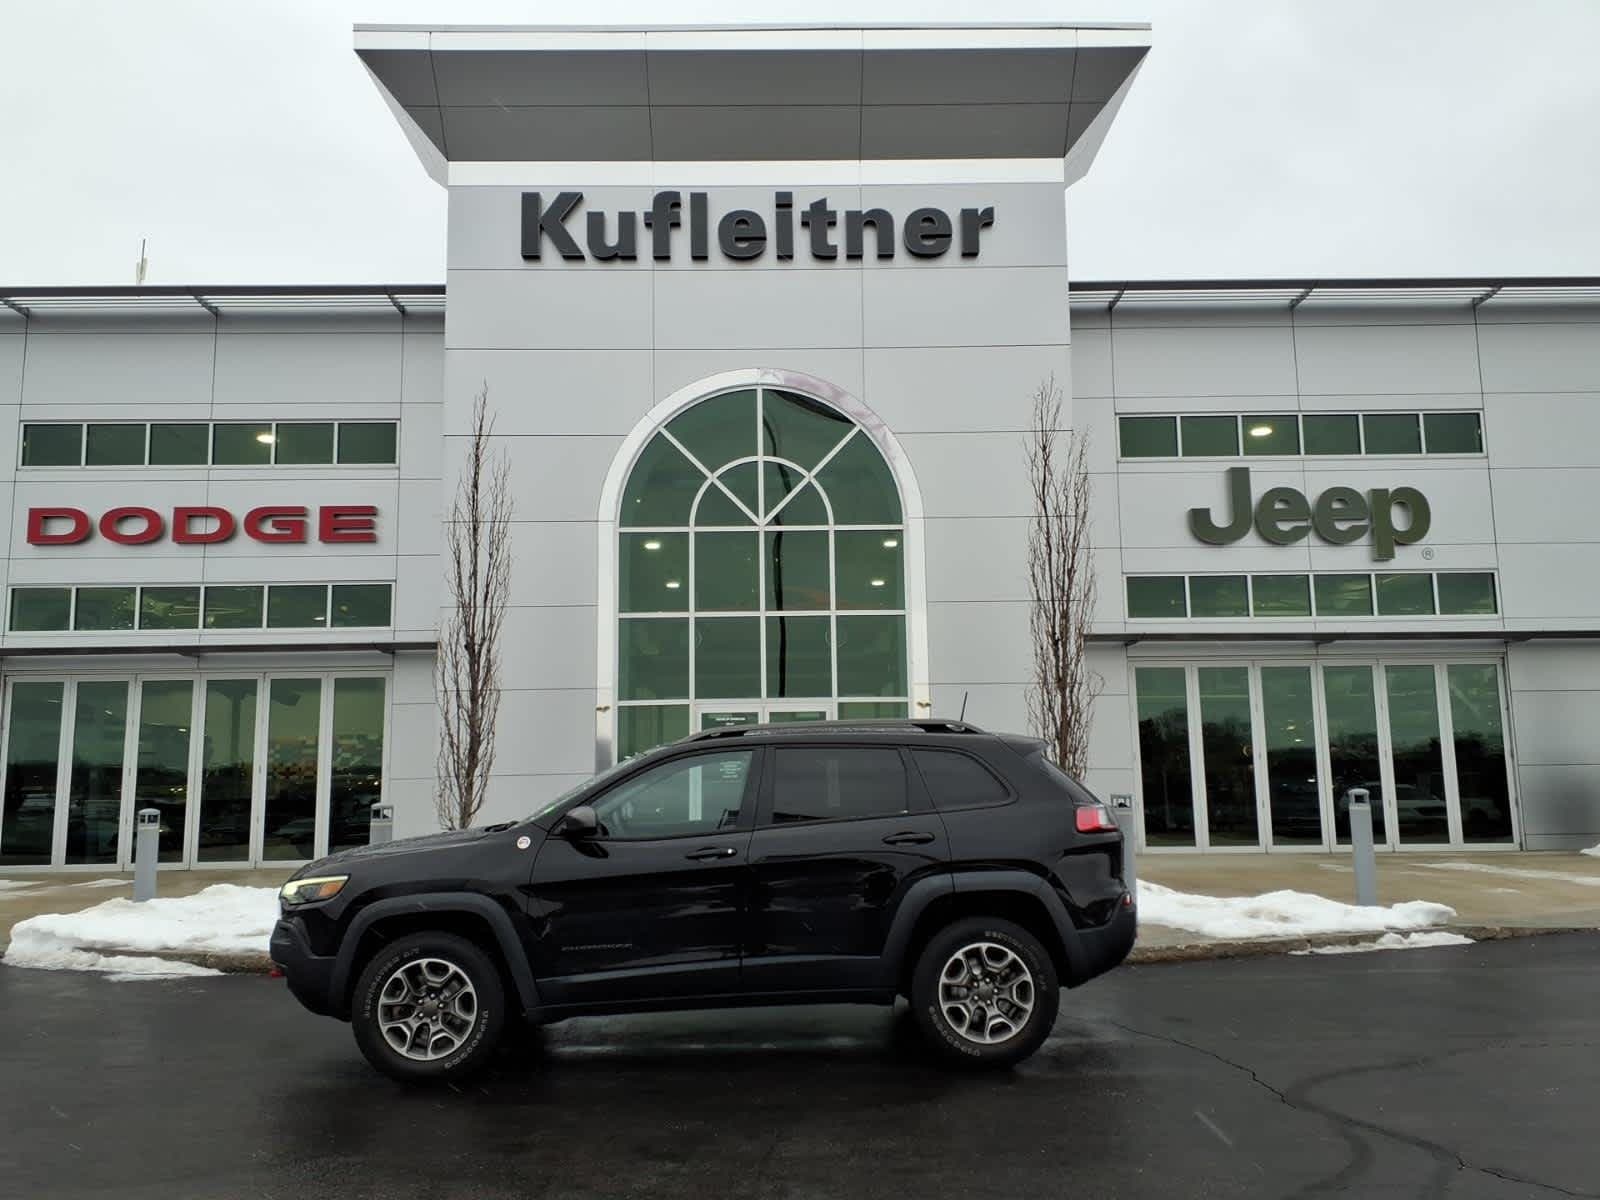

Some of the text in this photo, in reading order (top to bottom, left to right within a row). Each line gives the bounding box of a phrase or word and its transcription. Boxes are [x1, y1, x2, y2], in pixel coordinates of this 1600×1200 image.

[521, 190, 995, 261] Kufleitner
[27, 505, 378, 546] DODGE
[1188, 467, 1431, 561] Jeep
